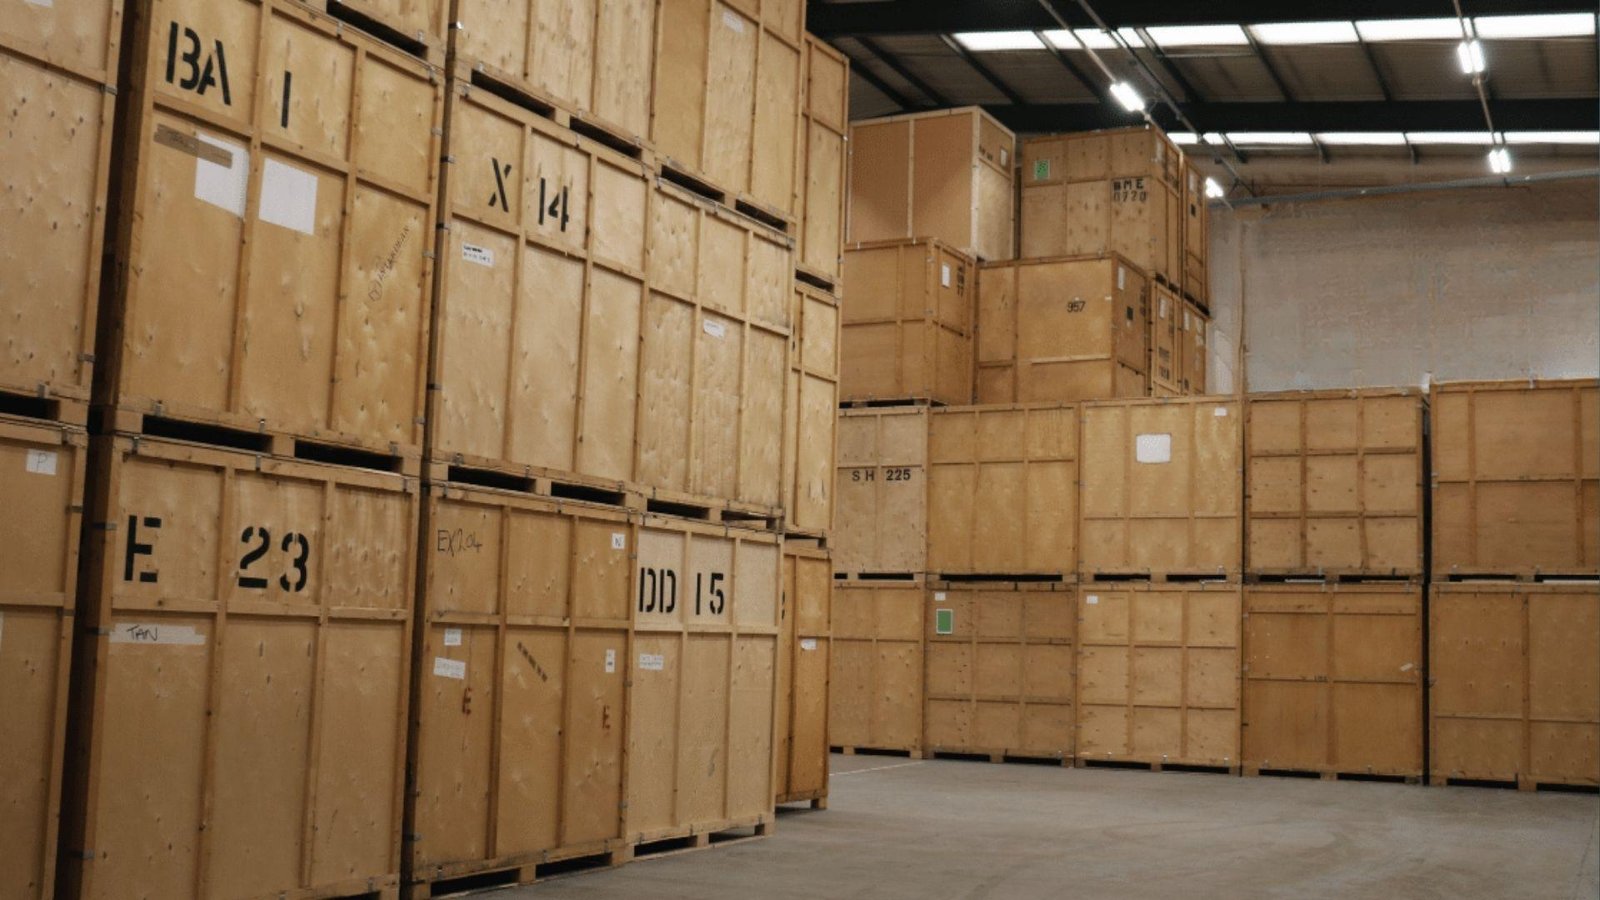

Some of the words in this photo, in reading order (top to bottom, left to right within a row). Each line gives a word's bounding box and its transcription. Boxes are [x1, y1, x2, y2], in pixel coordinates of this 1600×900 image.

[165, 21, 231, 106] BA
[488, 157, 512, 213] X
[538, 177, 569, 232] 14
[1066, 300, 1086, 313] 957
[886, 468, 911, 481] 225
[124, 515, 161, 583] E
[238, 526, 309, 592] 23
[639, 567, 676, 613] DD
[696, 572, 724, 615] 15
[126, 624, 158, 641] TAN
